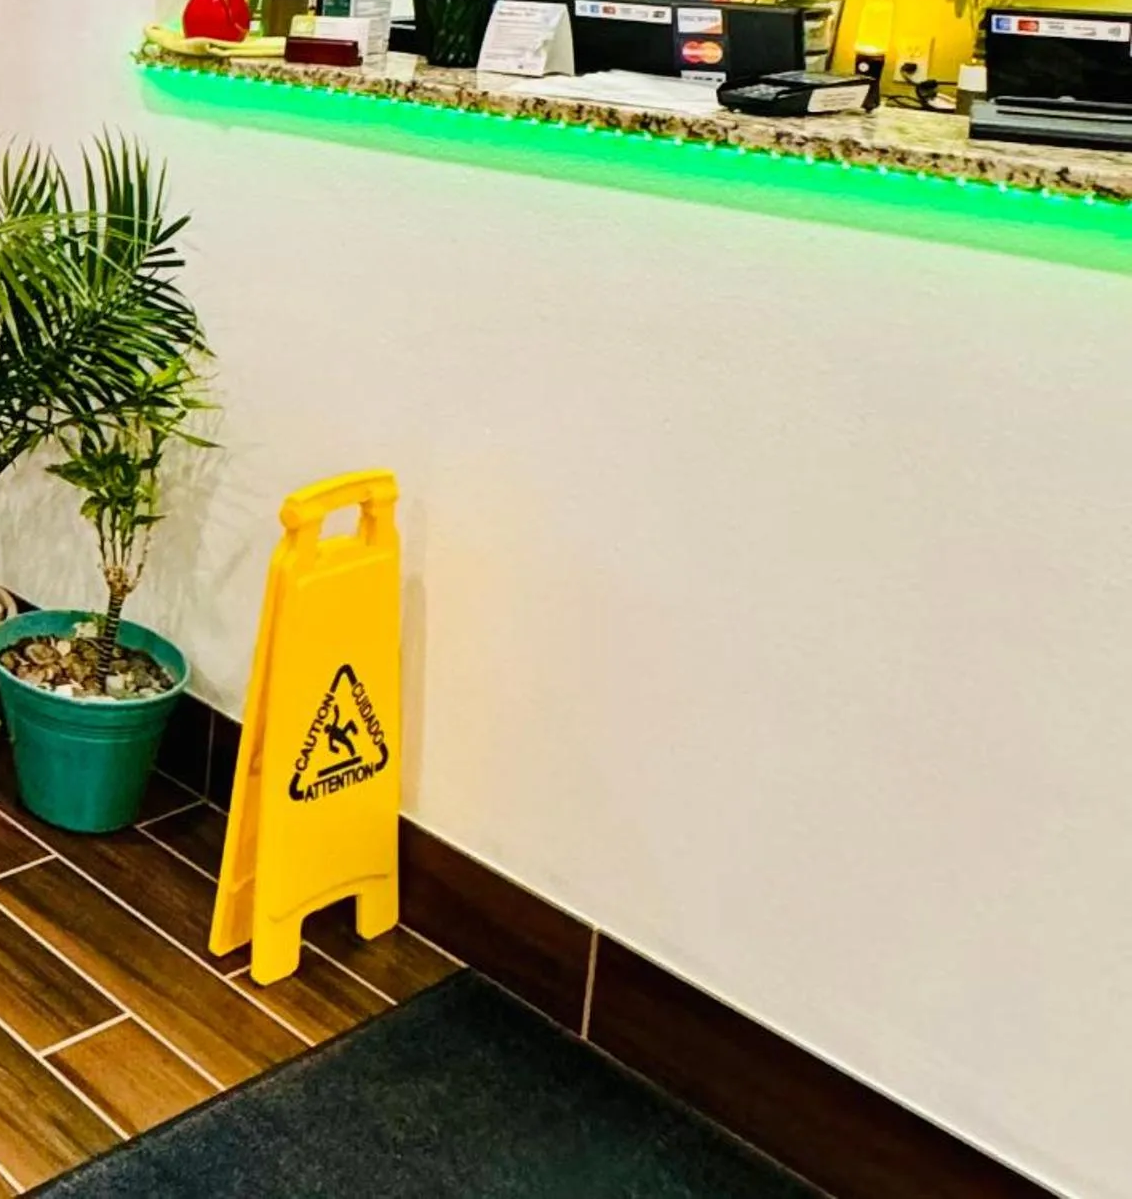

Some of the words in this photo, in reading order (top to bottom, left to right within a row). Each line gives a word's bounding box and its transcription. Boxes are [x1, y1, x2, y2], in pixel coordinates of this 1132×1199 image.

[295, 693, 335, 771] CAUTION
[351, 682, 385, 746] CUIDADO
[304, 762, 375, 802] ATTENTION
